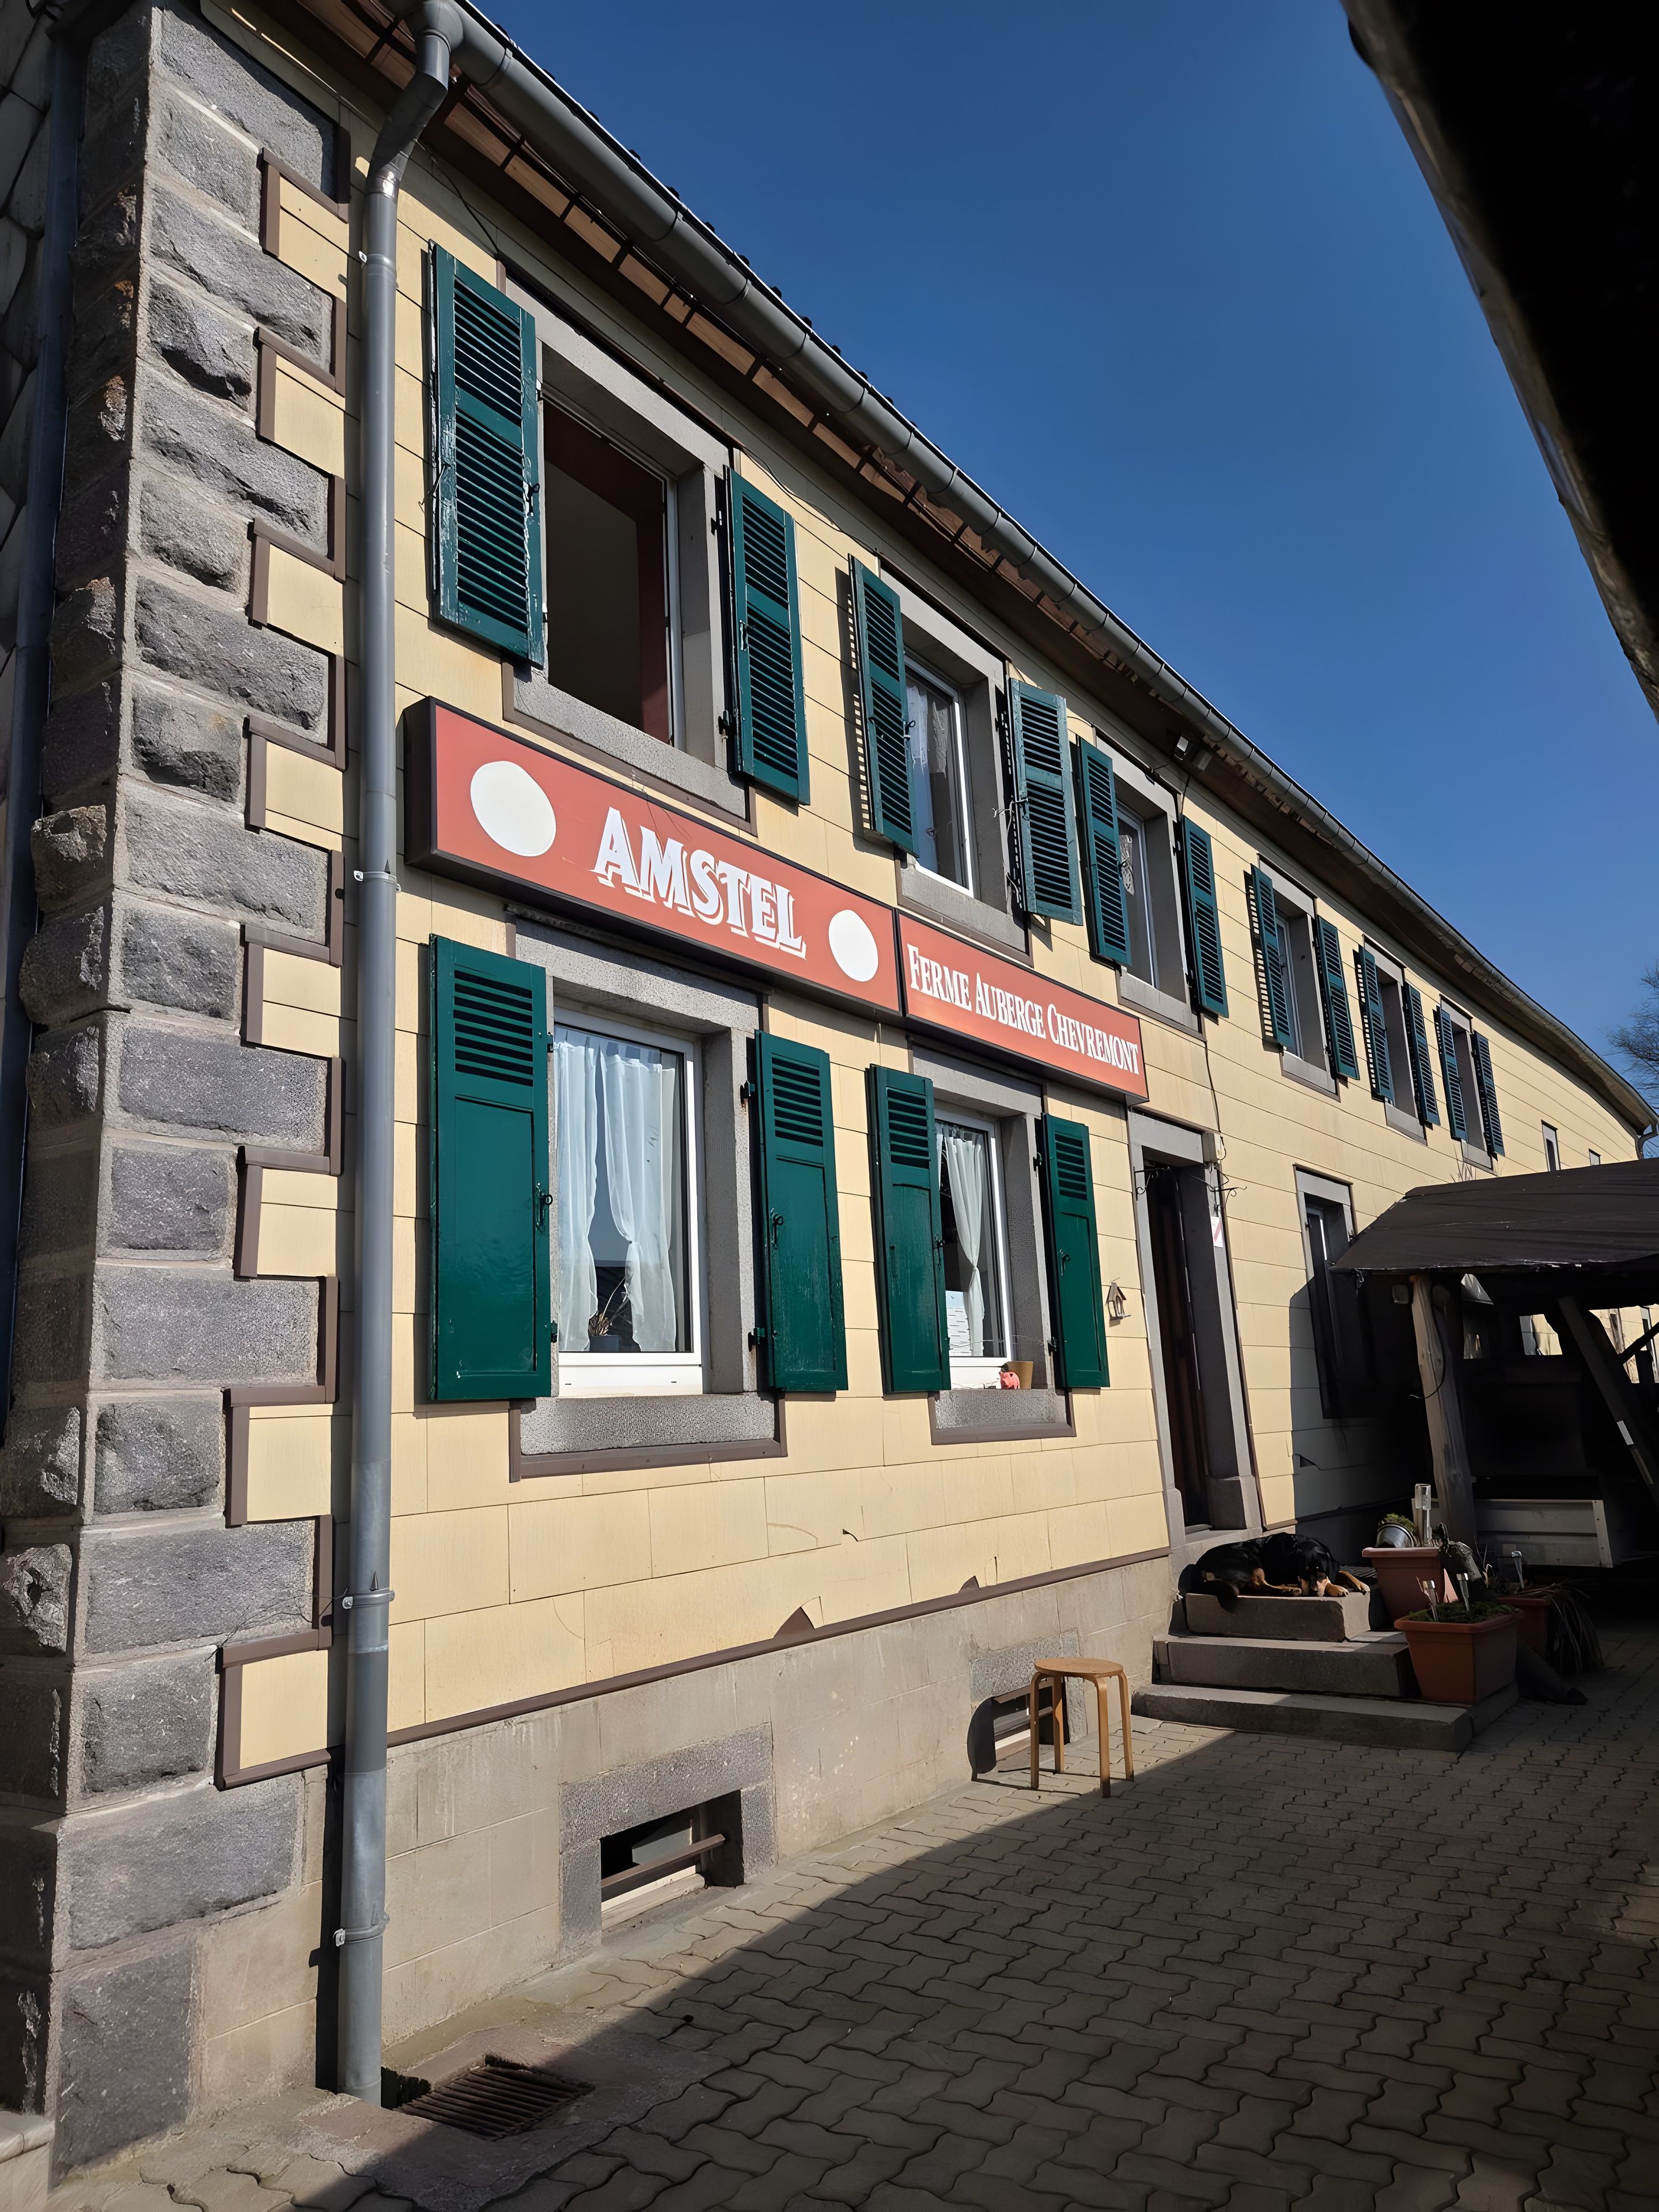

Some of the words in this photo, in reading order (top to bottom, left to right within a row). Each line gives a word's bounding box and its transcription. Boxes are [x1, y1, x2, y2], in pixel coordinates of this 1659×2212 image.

[590, 806, 806, 960] AMSTEL
[907, 943, 972, 1012] FERME
[975, 972, 1046, 1039] AUBERGE
[1047, 1003, 1139, 1075] CHEVREMONT
